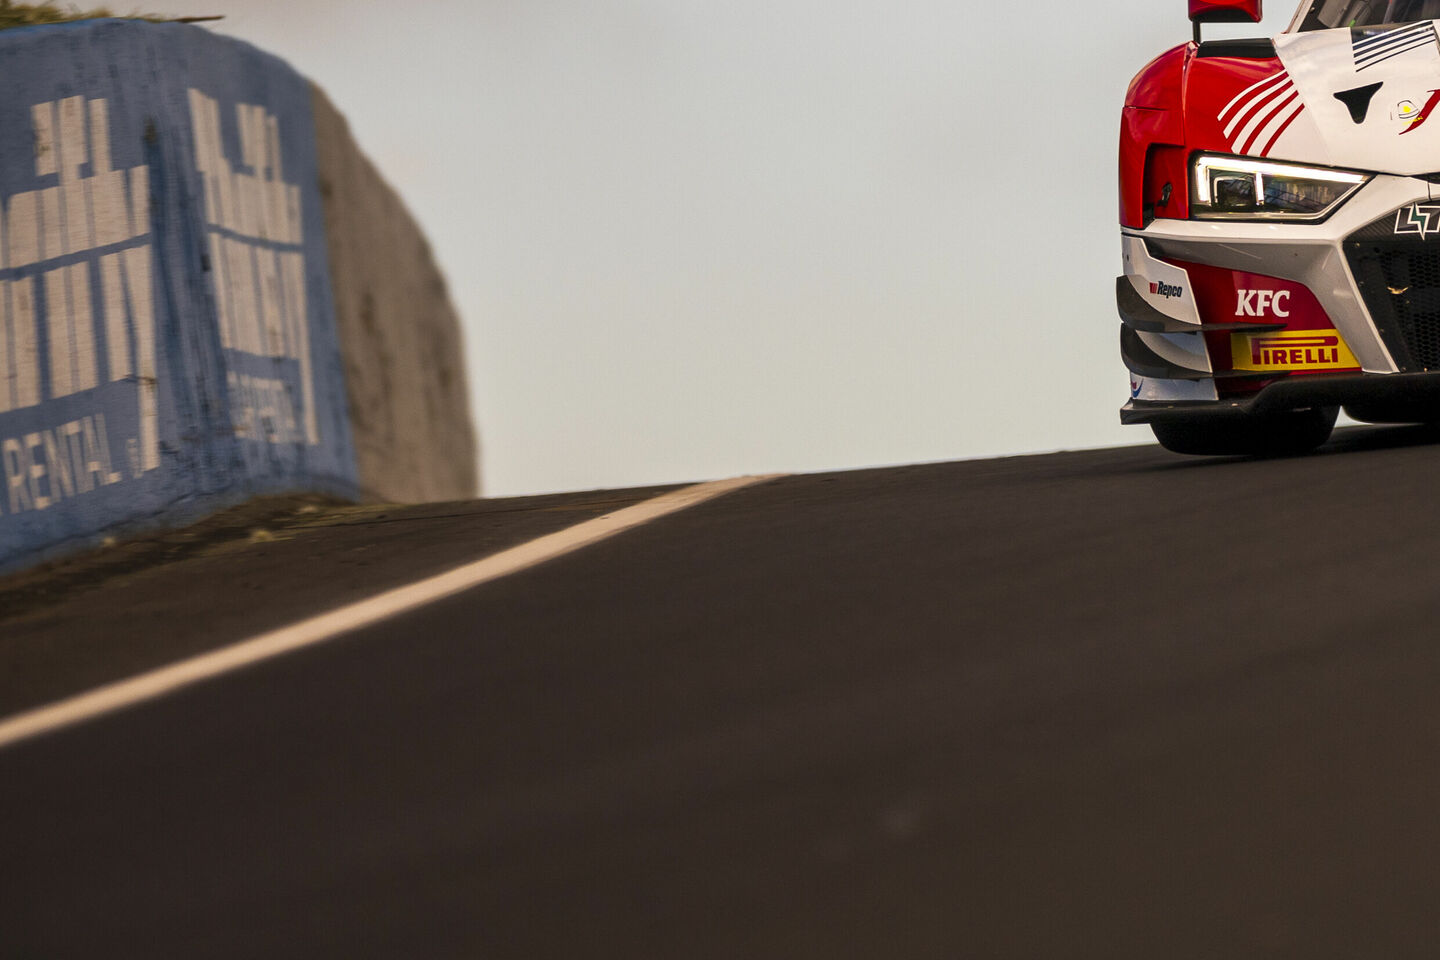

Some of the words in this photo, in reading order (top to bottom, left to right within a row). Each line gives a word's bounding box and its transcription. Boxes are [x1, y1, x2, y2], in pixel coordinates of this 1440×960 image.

[1157, 280, 1183, 299] Repco
[1234, 289, 1290, 318] KFC
[1251, 336, 1339, 365] PIRELLI
[3, 413, 123, 515] RENTAL
